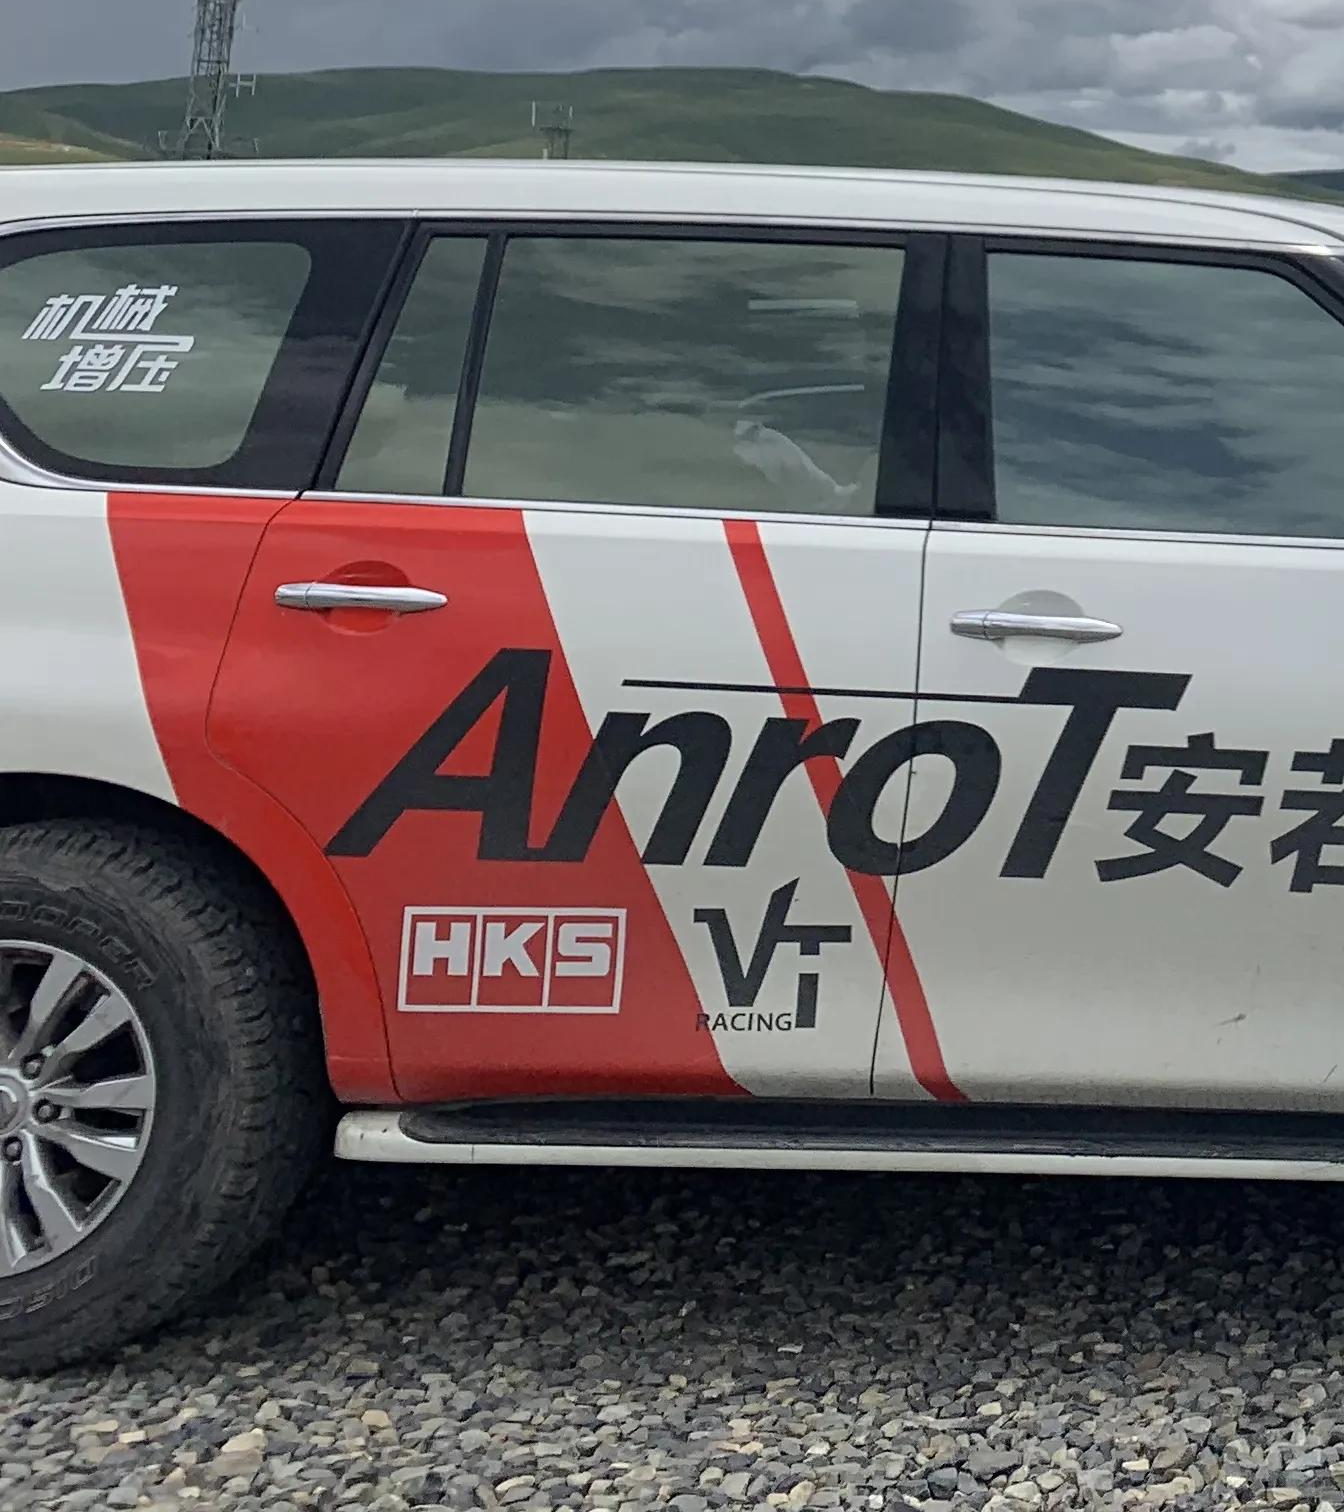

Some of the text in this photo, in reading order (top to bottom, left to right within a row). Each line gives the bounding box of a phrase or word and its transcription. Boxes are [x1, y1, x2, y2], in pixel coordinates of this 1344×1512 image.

[22, 284, 178, 340] 机械
[40, 344, 194, 392] 增压
[326, 648, 1192, 879] AnroT
[412, 918, 614, 977] HKS
[696, 1012, 792, 1031] RACING
